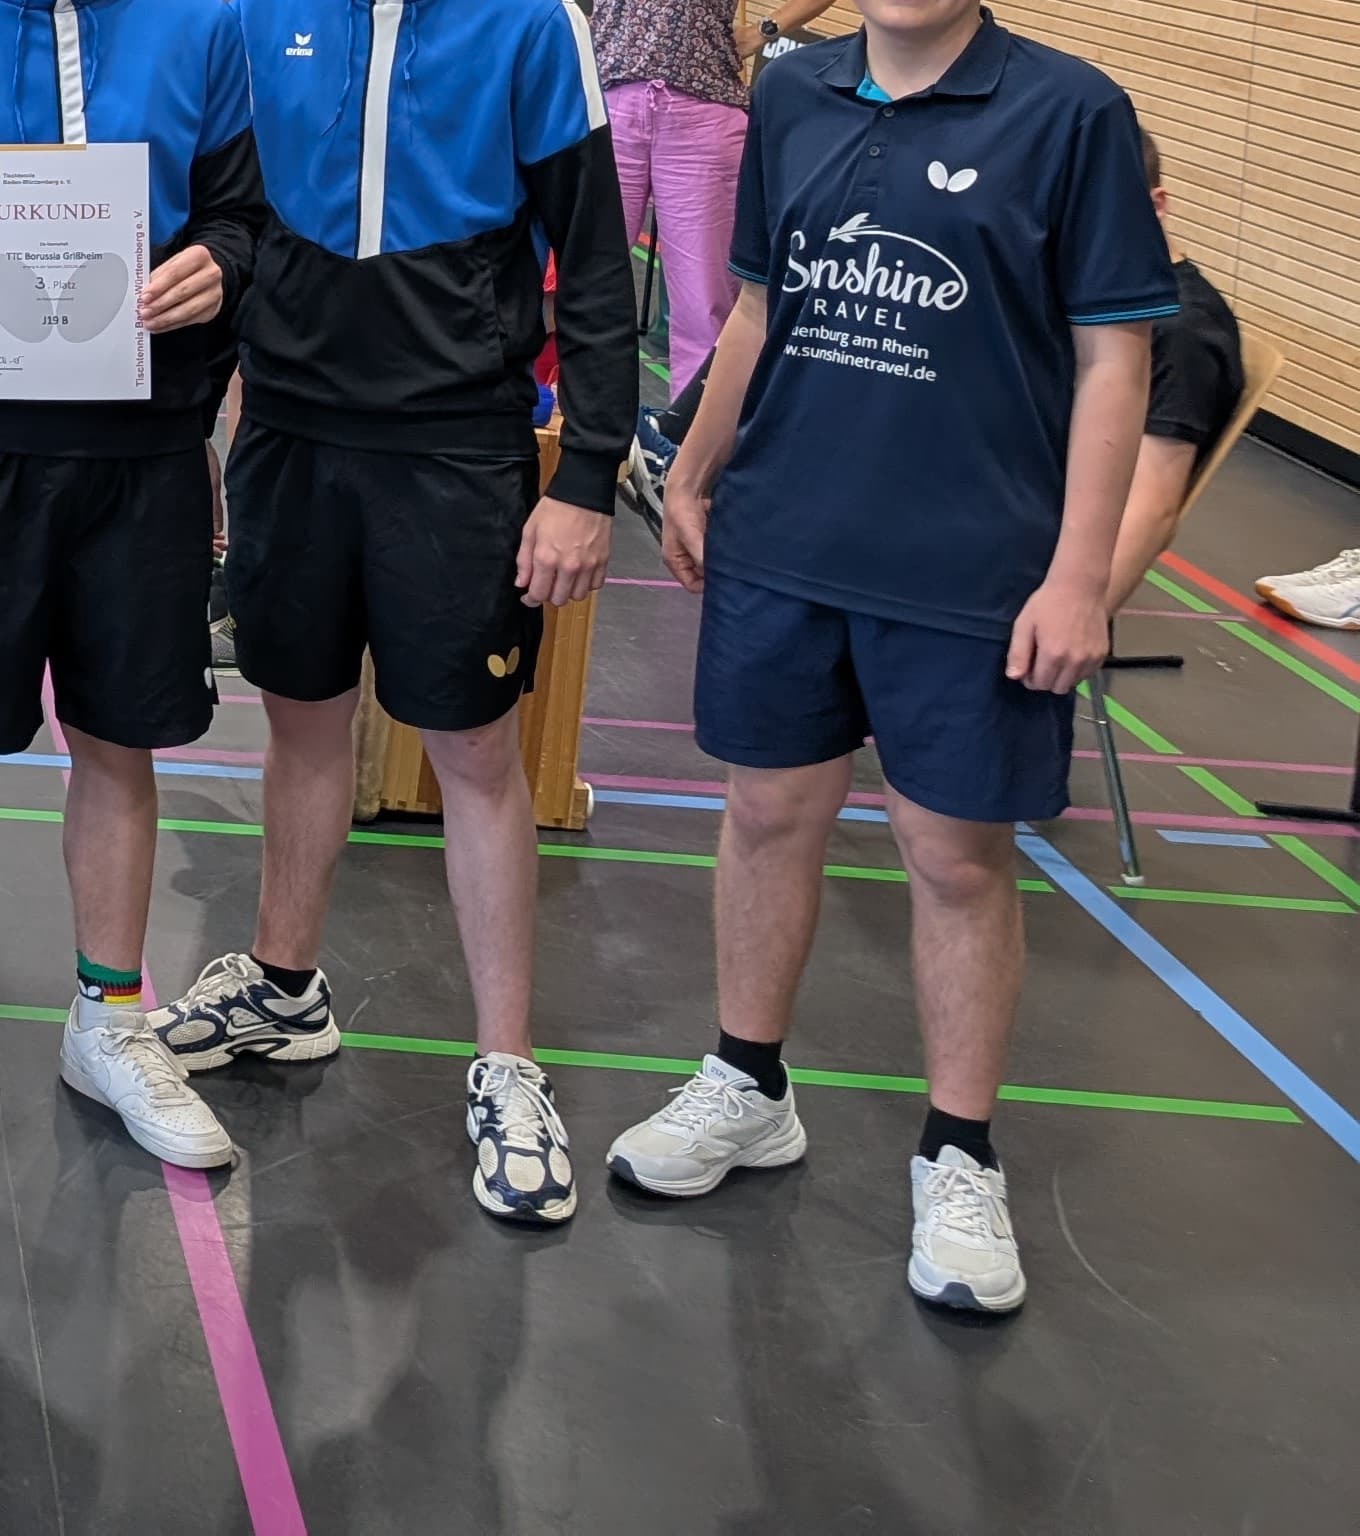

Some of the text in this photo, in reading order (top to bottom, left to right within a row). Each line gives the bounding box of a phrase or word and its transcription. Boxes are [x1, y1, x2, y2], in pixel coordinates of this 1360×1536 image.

[6, 251, 103, 261] TTC Borussia Grißheim
[53, 280, 76, 290] Platz
[42, 315, 69, 325] J19 B
[813, 298, 907, 331] RAVEL
[791, 325, 930, 360] uenburg am Rhein
[783, 344, 937, 382] w.sunshinetravel.de
